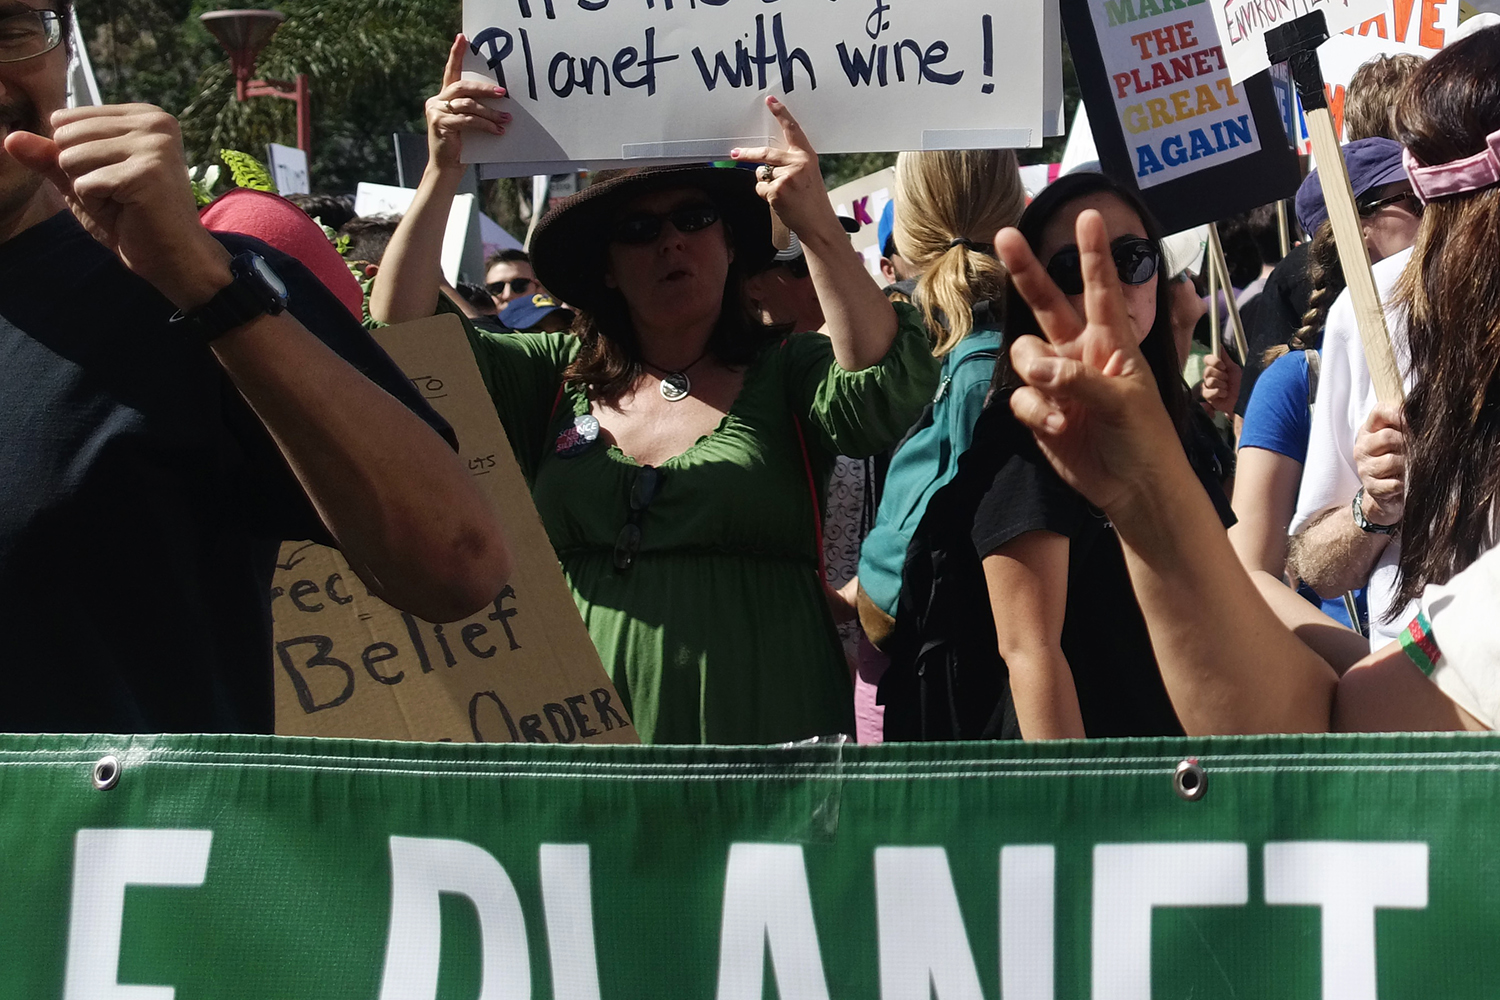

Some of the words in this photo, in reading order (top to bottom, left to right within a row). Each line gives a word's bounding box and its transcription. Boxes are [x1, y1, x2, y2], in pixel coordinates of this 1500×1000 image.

[469, 25, 680, 101] Planet
[690, 12, 818, 98] with
[1130, 19, 1199, 61] THE
[1112, 44, 1229, 100] PLANET
[1122, 76, 1241, 136] GREAT
[1136, 113, 1254, 178] AGAIN
[276, 584, 521, 714] Belief
